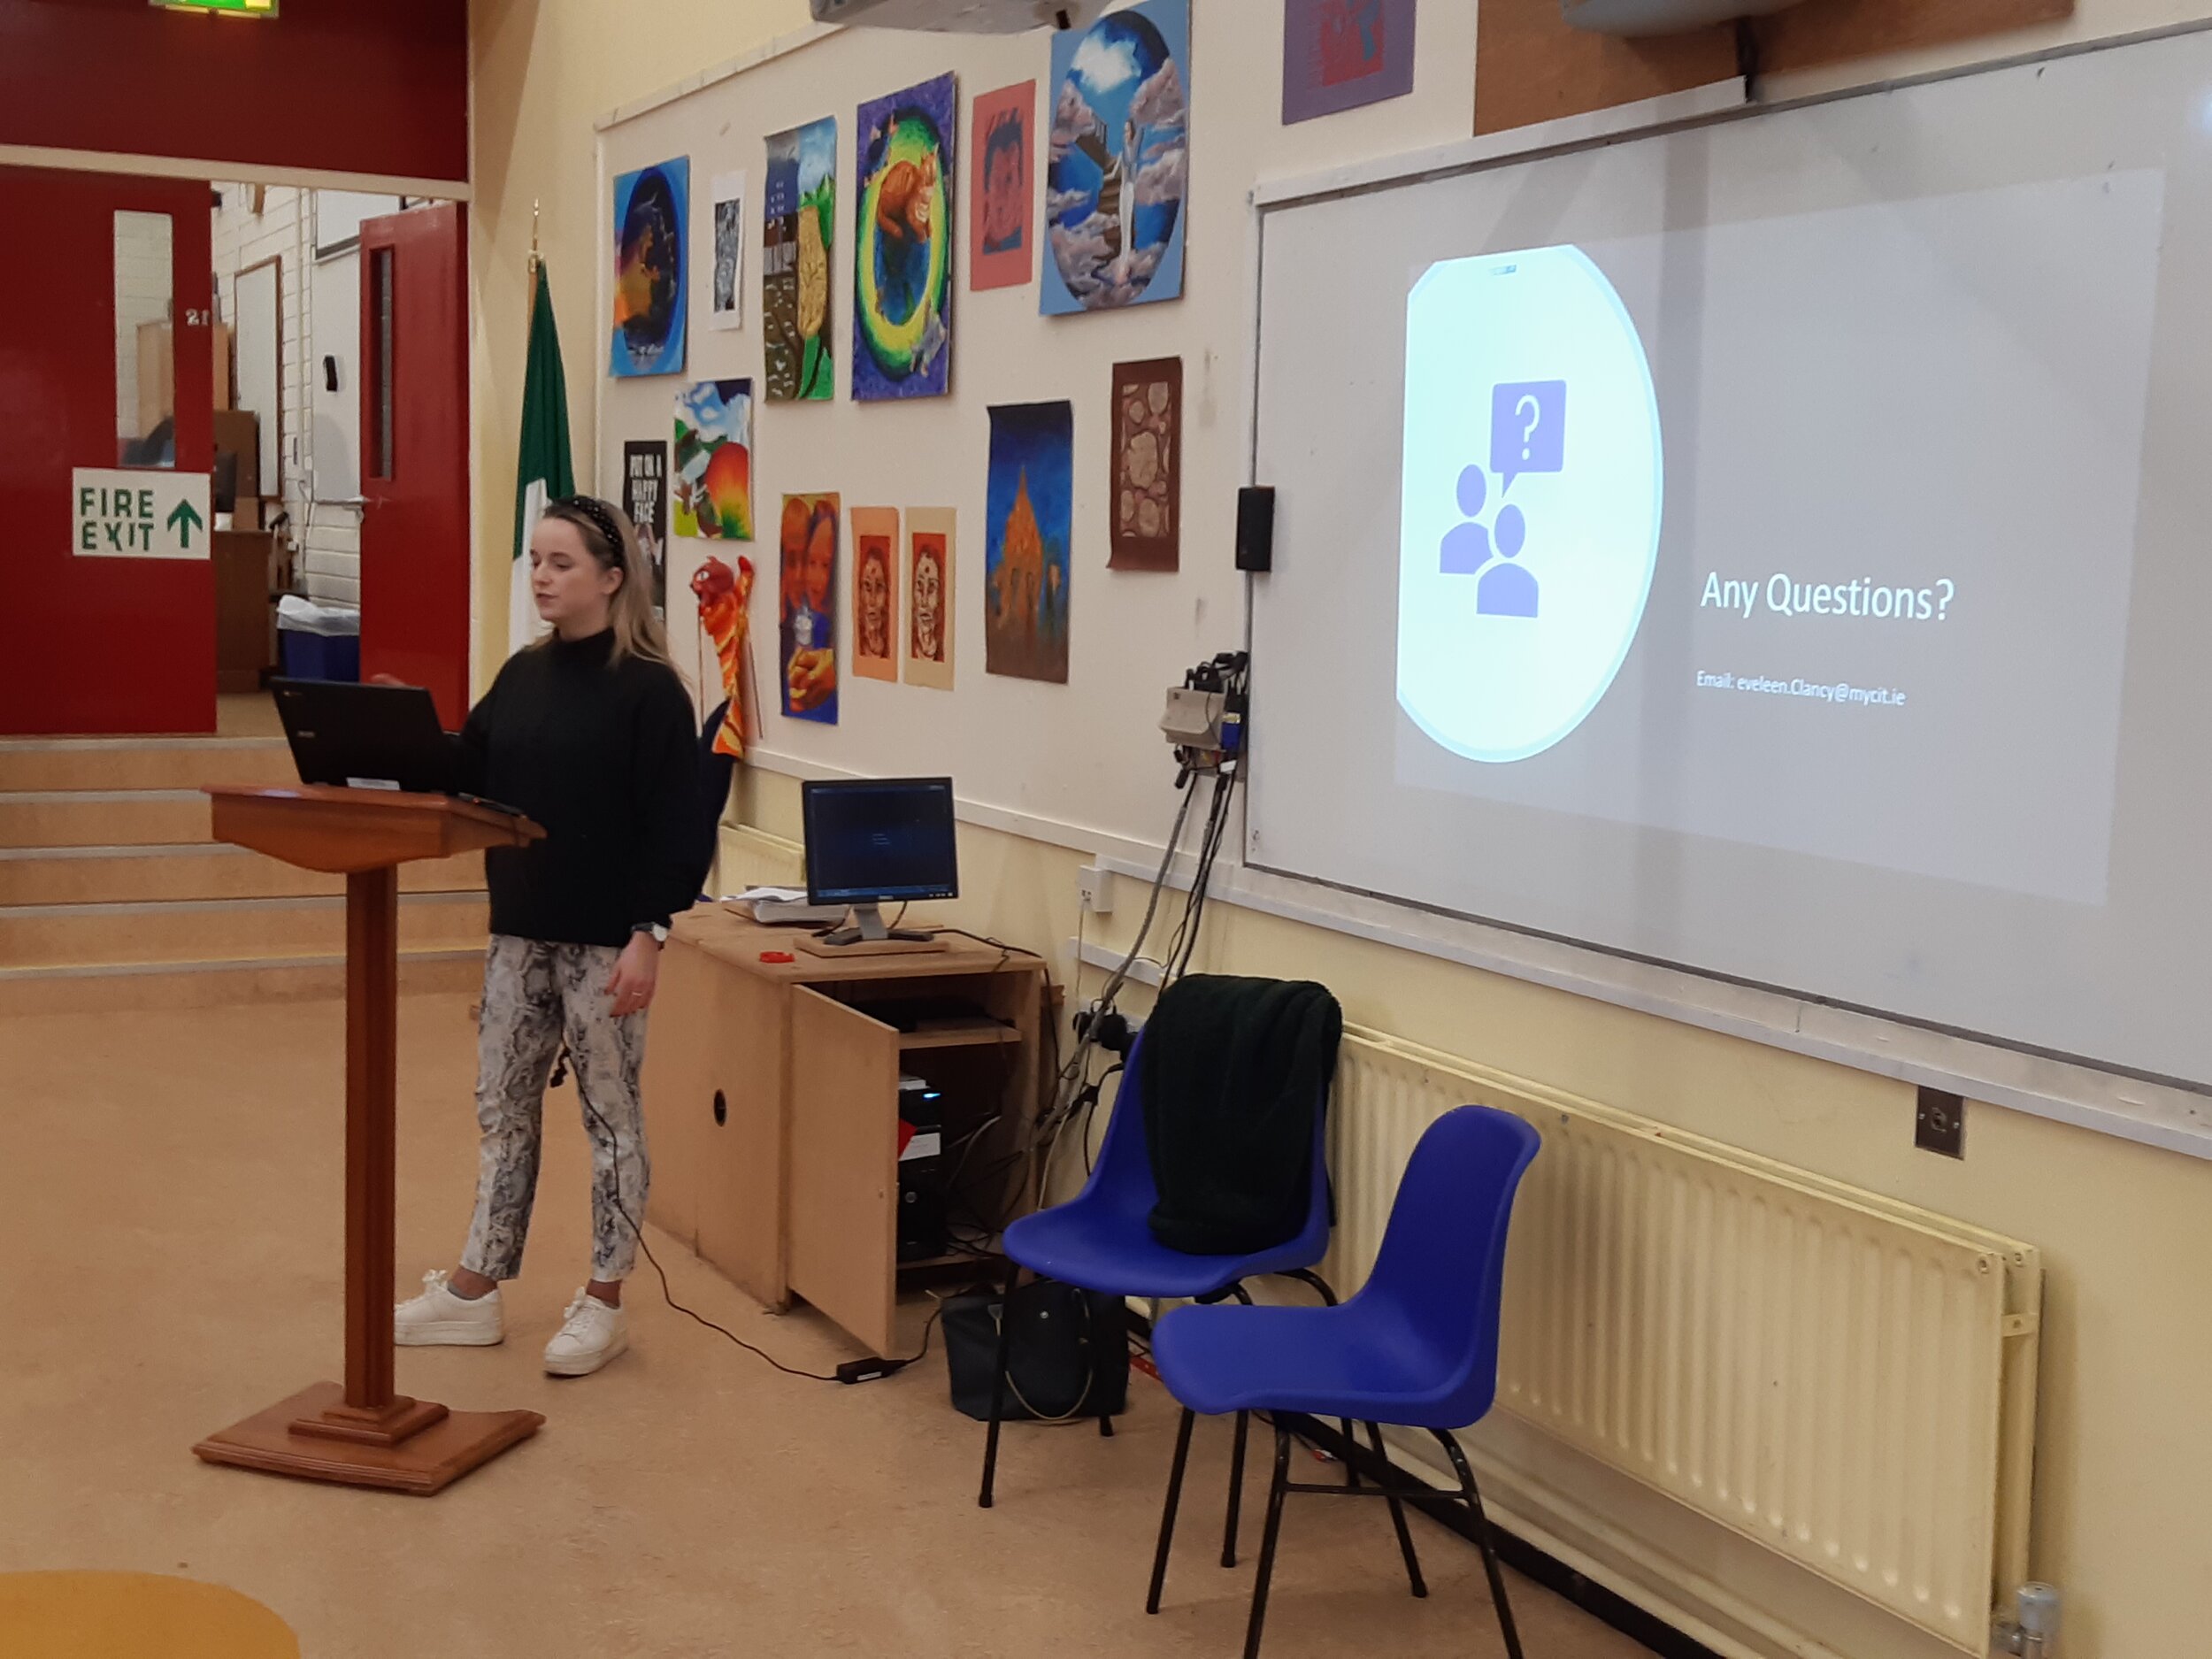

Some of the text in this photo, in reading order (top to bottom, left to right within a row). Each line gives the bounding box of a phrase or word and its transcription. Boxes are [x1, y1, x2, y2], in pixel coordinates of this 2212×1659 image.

[80, 487, 154, 518] FIRE
[632, 479, 658, 502] HAPPY
[634, 502, 655, 523] FACE
[81, 520, 154, 551] EXIT
[1700, 572, 1955, 620] Any Questions?
[1697, 671, 1734, 688] Email:
